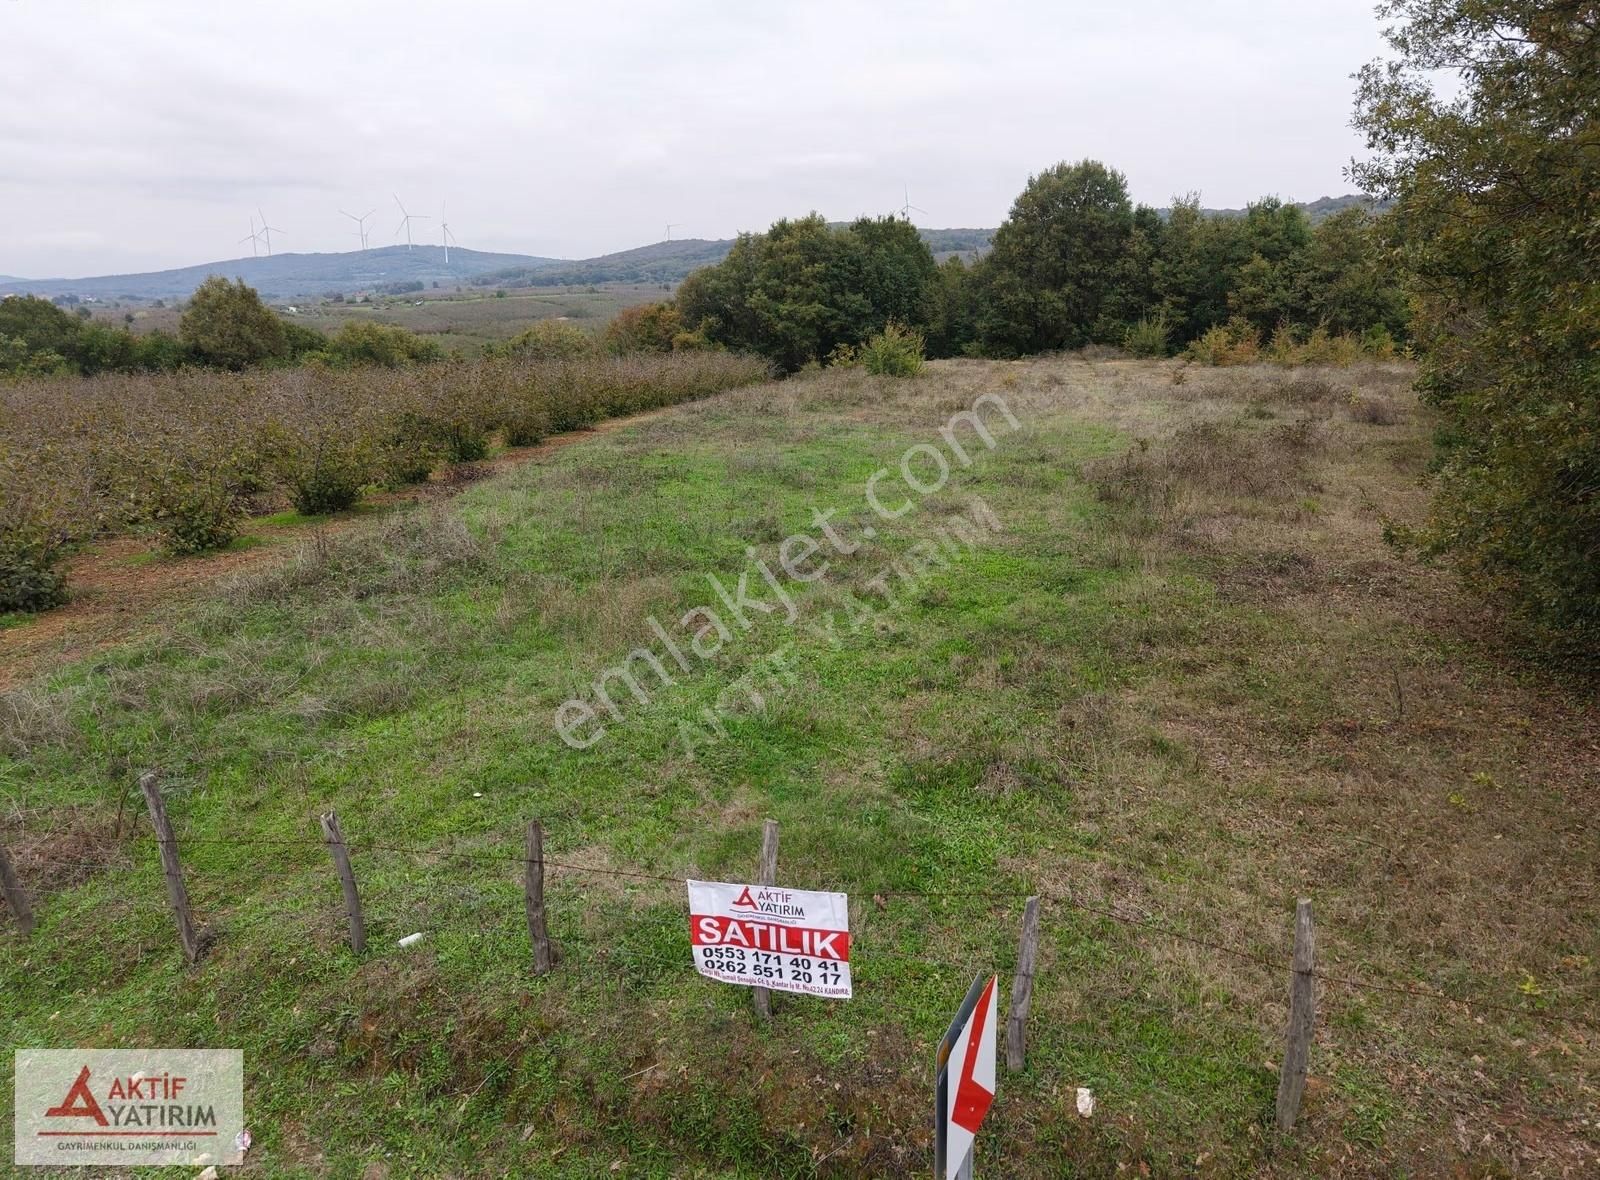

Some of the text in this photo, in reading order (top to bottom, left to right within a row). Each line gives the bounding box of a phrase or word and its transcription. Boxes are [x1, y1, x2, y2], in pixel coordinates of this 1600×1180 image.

[757, 890, 792, 903] AKTİF
[758, 902, 805, 917] YATIRIM
[698, 916, 841, 959] SATILIK
[702, 947, 839, 972] 0553 171 40 41
[704, 959, 841, 986] 0262 551 20 17
